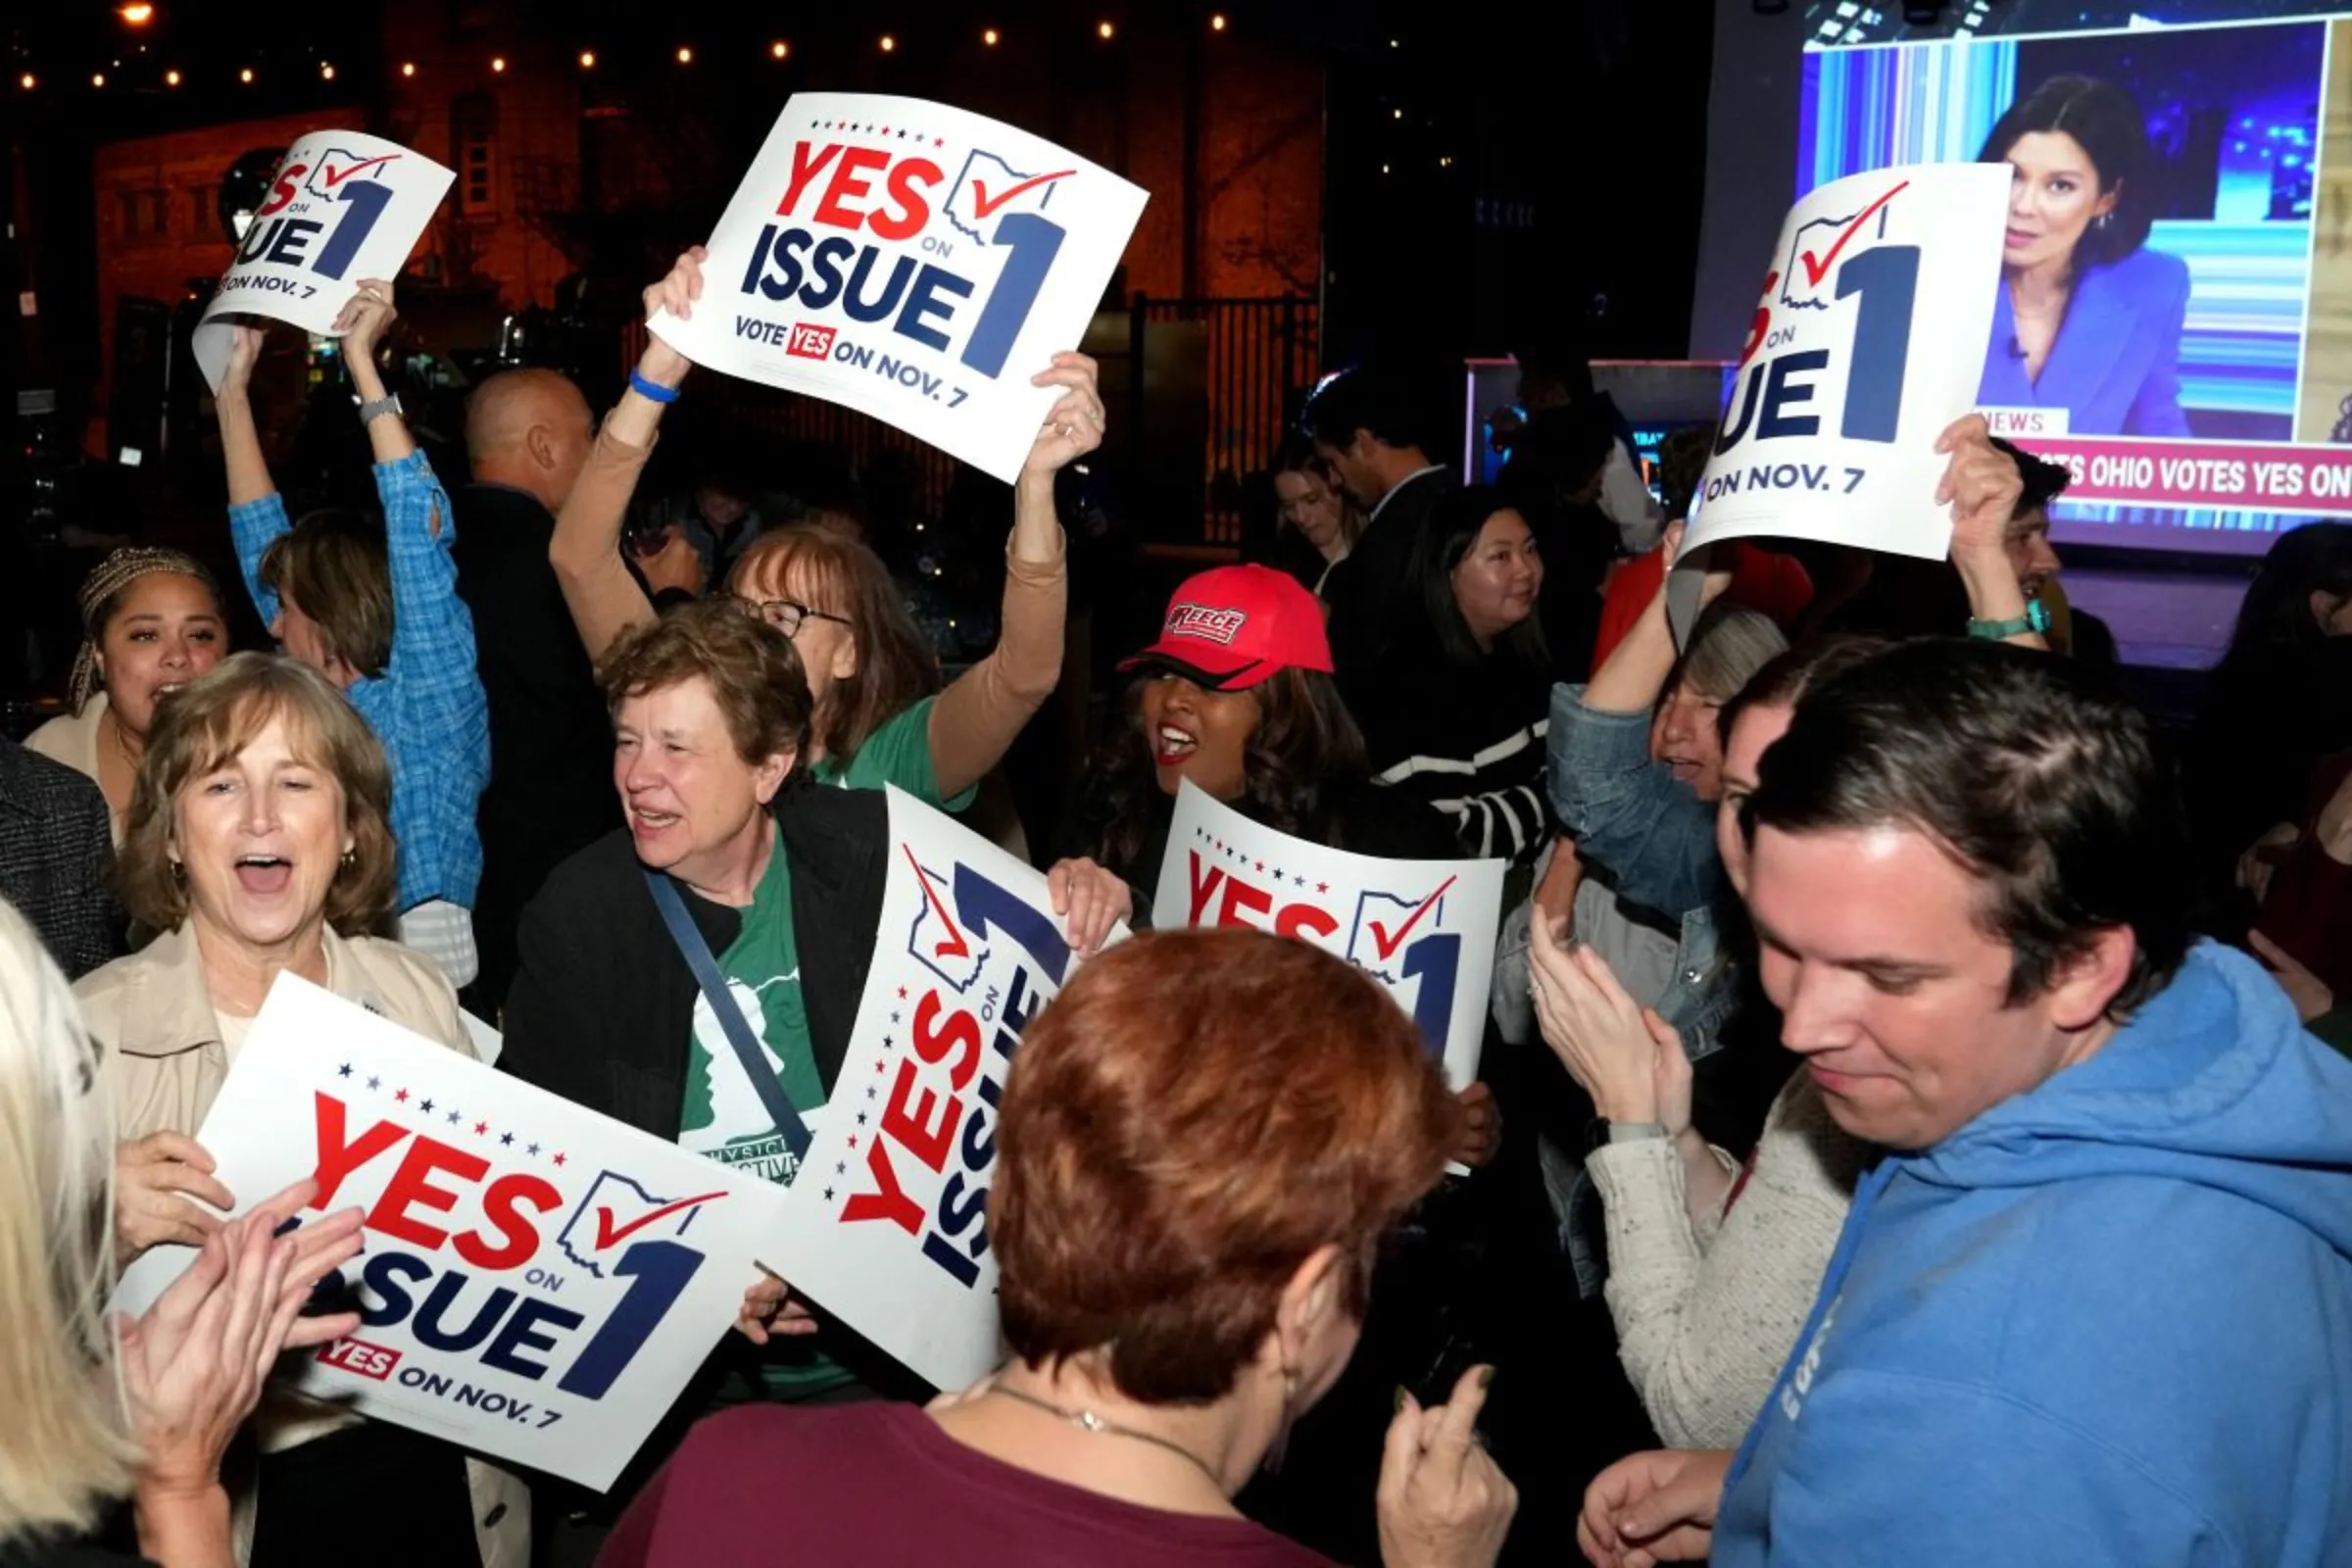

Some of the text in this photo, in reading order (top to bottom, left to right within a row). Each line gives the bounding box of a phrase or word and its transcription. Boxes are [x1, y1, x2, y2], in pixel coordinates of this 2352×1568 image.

[288, 202, 311, 214] ON
[311, 179, 395, 281] 1
[776, 140, 955, 260] YES ON
[251, 275, 297, 296] NOV.
[300, 285, 318, 299] 7
[741, 213, 1067, 380] ISSUE 1
[735, 315, 787, 347] VOTE
[790, 324, 833, 358] YES
[834, 341, 875, 371] ON
[876, 354, 941, 402] NOV.
[948, 386, 969, 410] 7
[1766, 325, 1796, 349] ON
[1835, 244, 1921, 444] 1
[1707, 469, 1740, 501] ON
[1747, 464, 1831, 491] NOV.
[1842, 467, 1866, 494] 7
[2090, 456, 2154, 489] OHIO
[2161, 458, 2245, 494] VOTES
[2253, 463, 2304, 496] YES
[2310, 465, 2351, 499] ON
[1167, 603, 1246, 632] REECE
[1401, 933, 1461, 1063] 1
[839, 985, 1001, 1237] YES ON
[305, 1089, 564, 1293] YES ON
[273, 1216, 707, 1401] SUE 1
[327, 1337, 393, 1376] YES
[398, 1365, 453, 1398] ON
[456, 1383, 528, 1425] NOV.
[537, 1411, 564, 1431] 7
